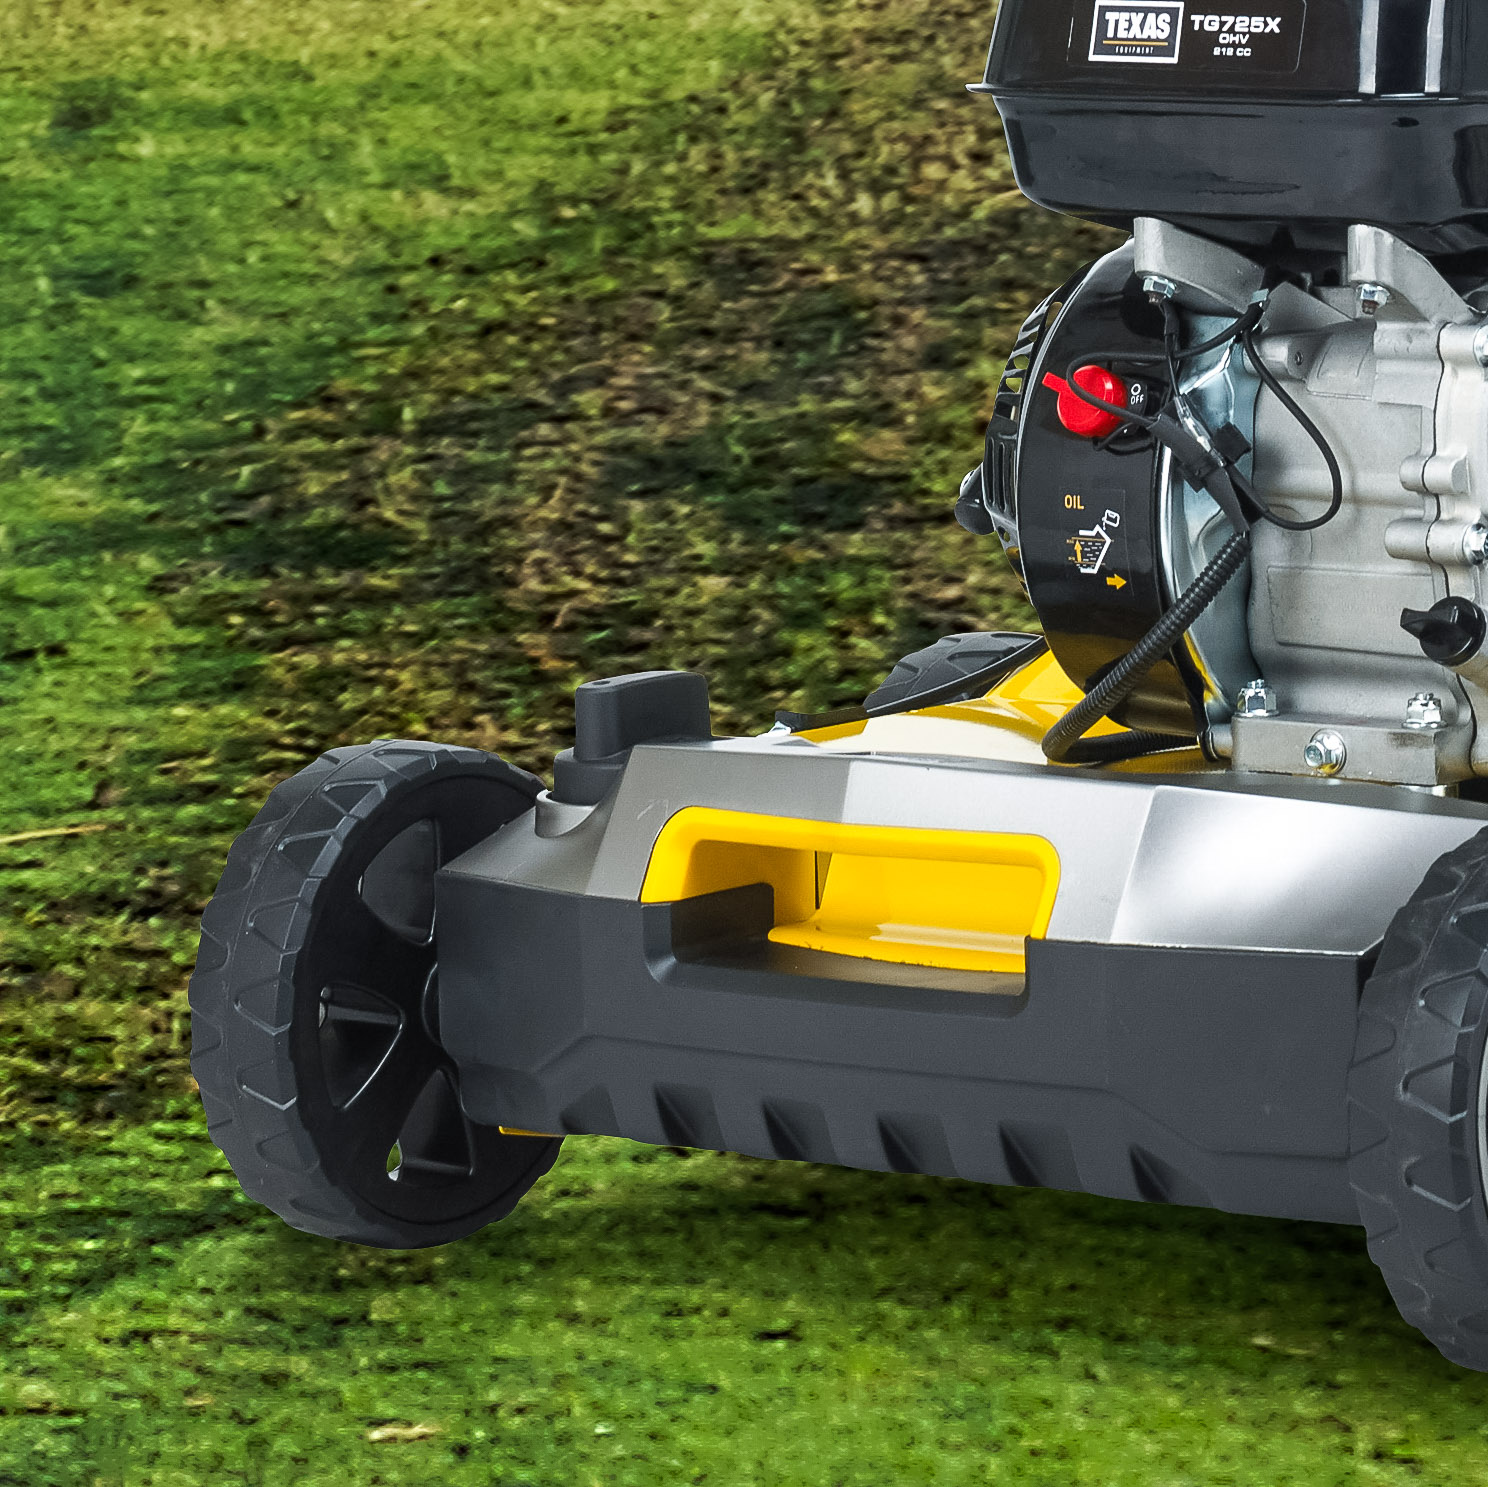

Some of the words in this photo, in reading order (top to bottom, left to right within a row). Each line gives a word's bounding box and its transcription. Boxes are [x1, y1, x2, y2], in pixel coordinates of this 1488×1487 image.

[1105, 12, 1170, 39] TEXAS
[1191, 15, 1281, 33] TG725X
[1219, 33, 1249, 44] OHV
[1236, 47, 1251, 56] CC
[1131, 394, 1144, 405] OFF
[1064, 495, 1084, 509] OIL
